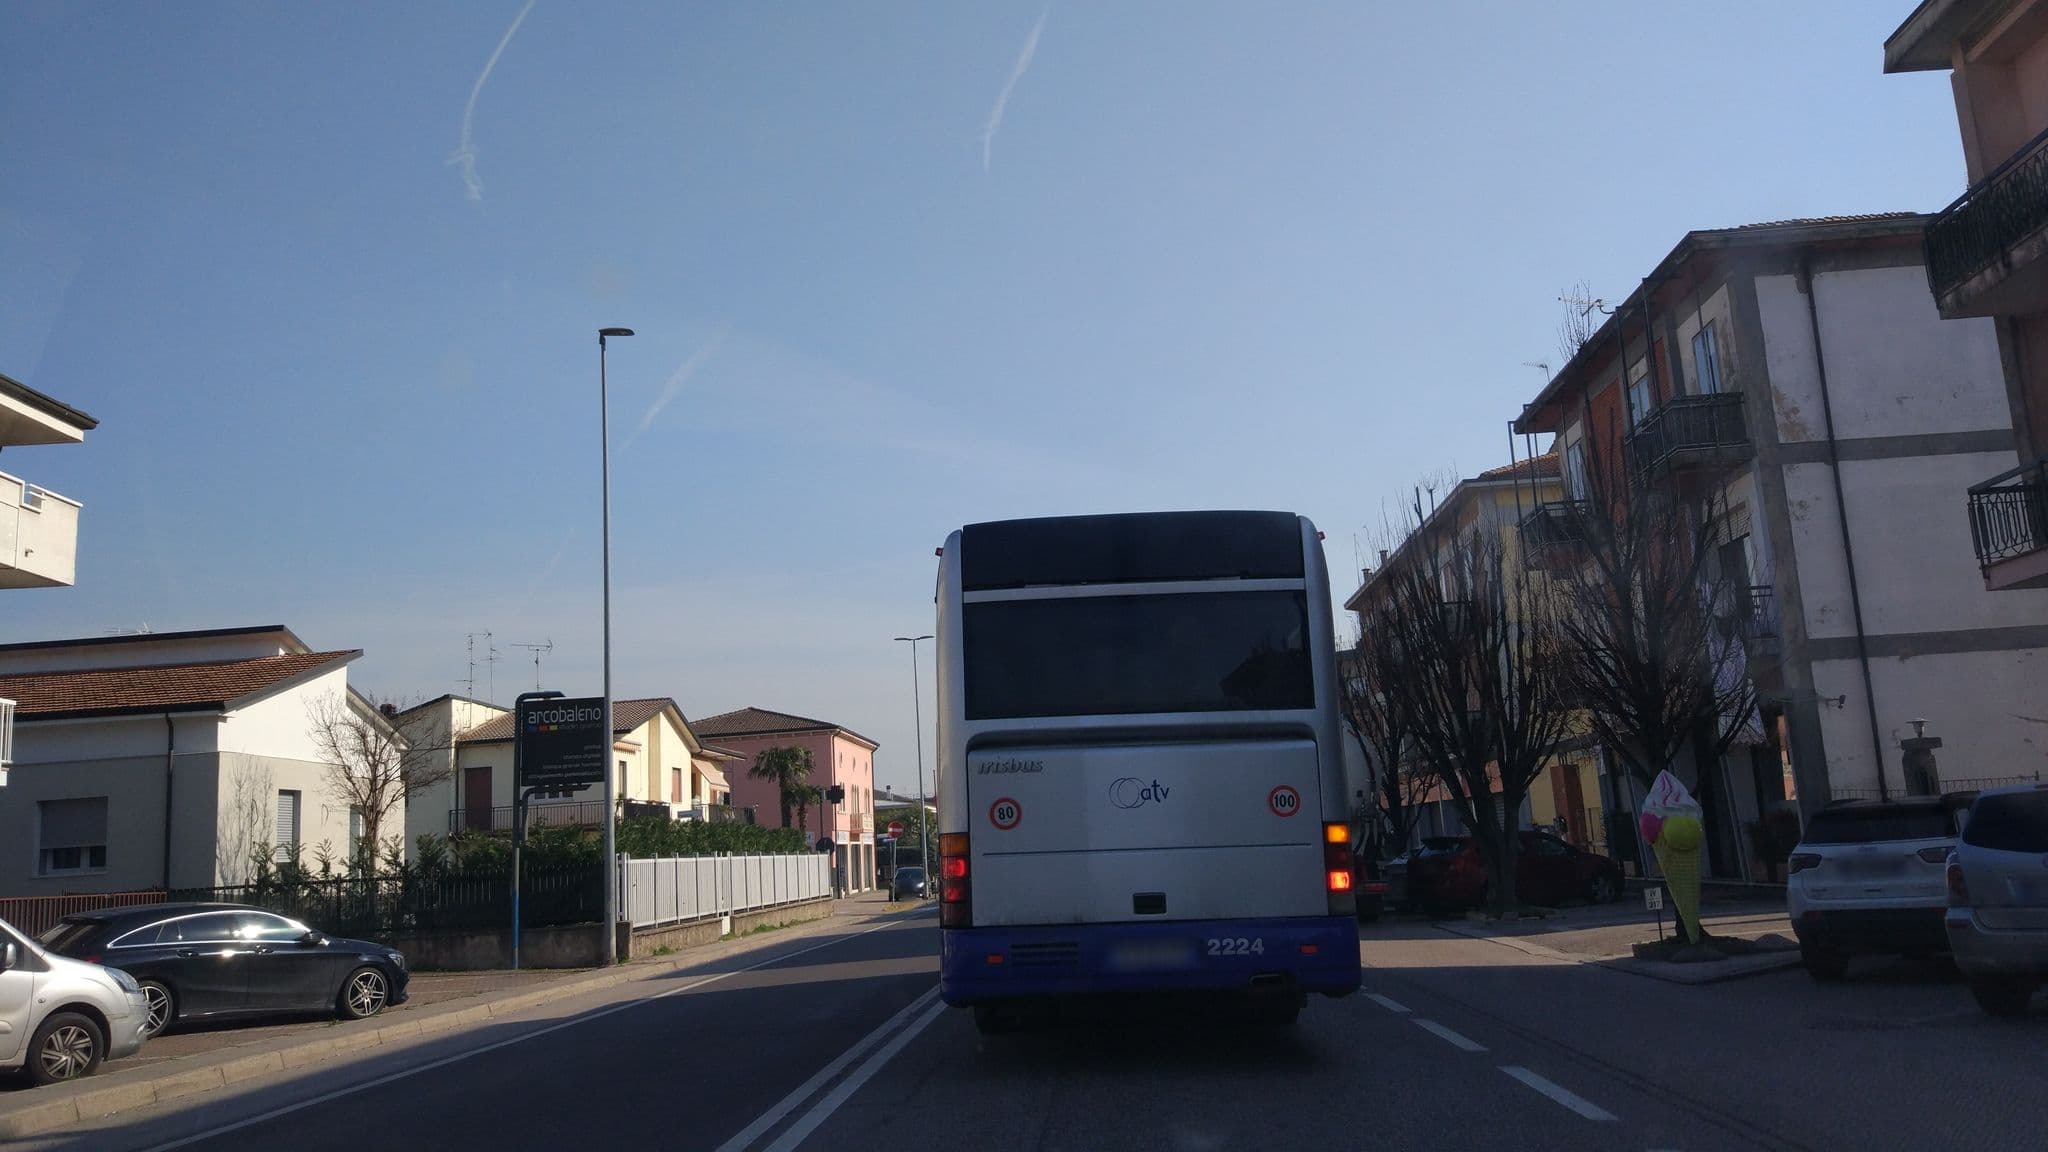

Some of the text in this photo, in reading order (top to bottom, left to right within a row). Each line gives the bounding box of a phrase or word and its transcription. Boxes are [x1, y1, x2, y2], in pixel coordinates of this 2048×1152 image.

[527, 704, 602, 724] arcobaleno
[1140, 778, 1170, 803] atv
[1274, 793, 1296, 808] 100
[998, 805, 1014, 821] 80
[1207, 937, 1265, 956] 2224
